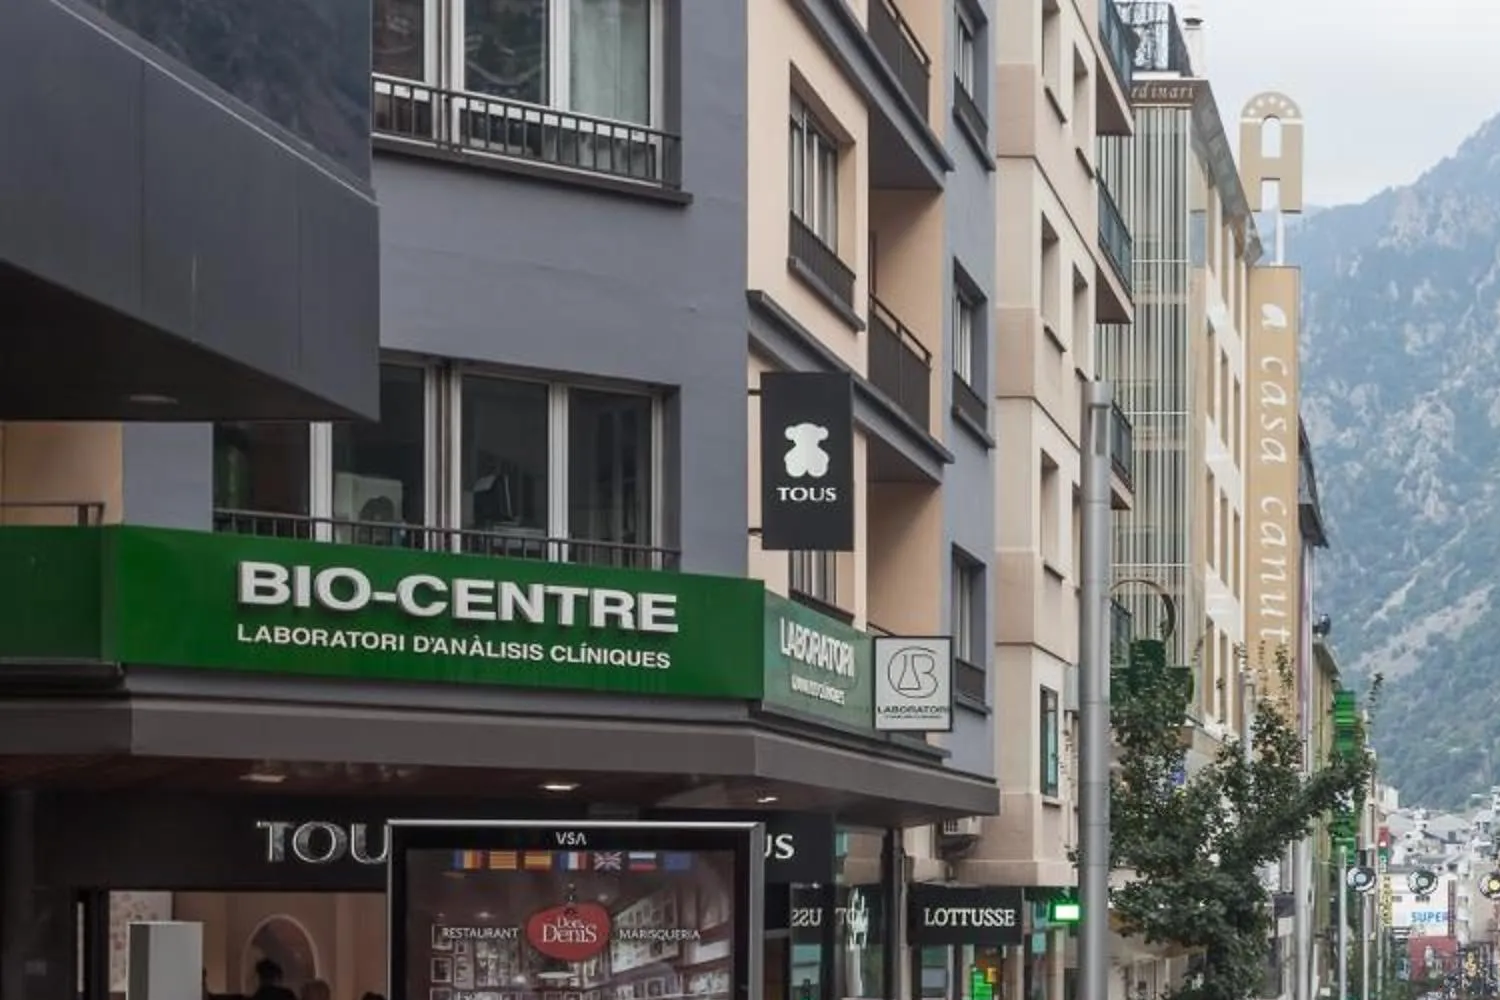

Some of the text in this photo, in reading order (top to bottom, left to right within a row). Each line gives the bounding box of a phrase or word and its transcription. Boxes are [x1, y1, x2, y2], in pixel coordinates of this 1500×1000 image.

[1131, 82, 1194, 99] rdinari
[1259, 355, 1289, 466] casa
[777, 486, 837, 502] TOUS
[1259, 495, 1290, 644] canut
[238, 560, 679, 633] BIO-CENTRE
[237, 624, 405, 652] LABORATORI
[549, 643, 671, 669] CLÍNIQUES
[256, 821, 389, 863] TOU
[442, 926, 519, 941] RESTAURANT
[923, 907, 1016, 928] LOTTUSSE
